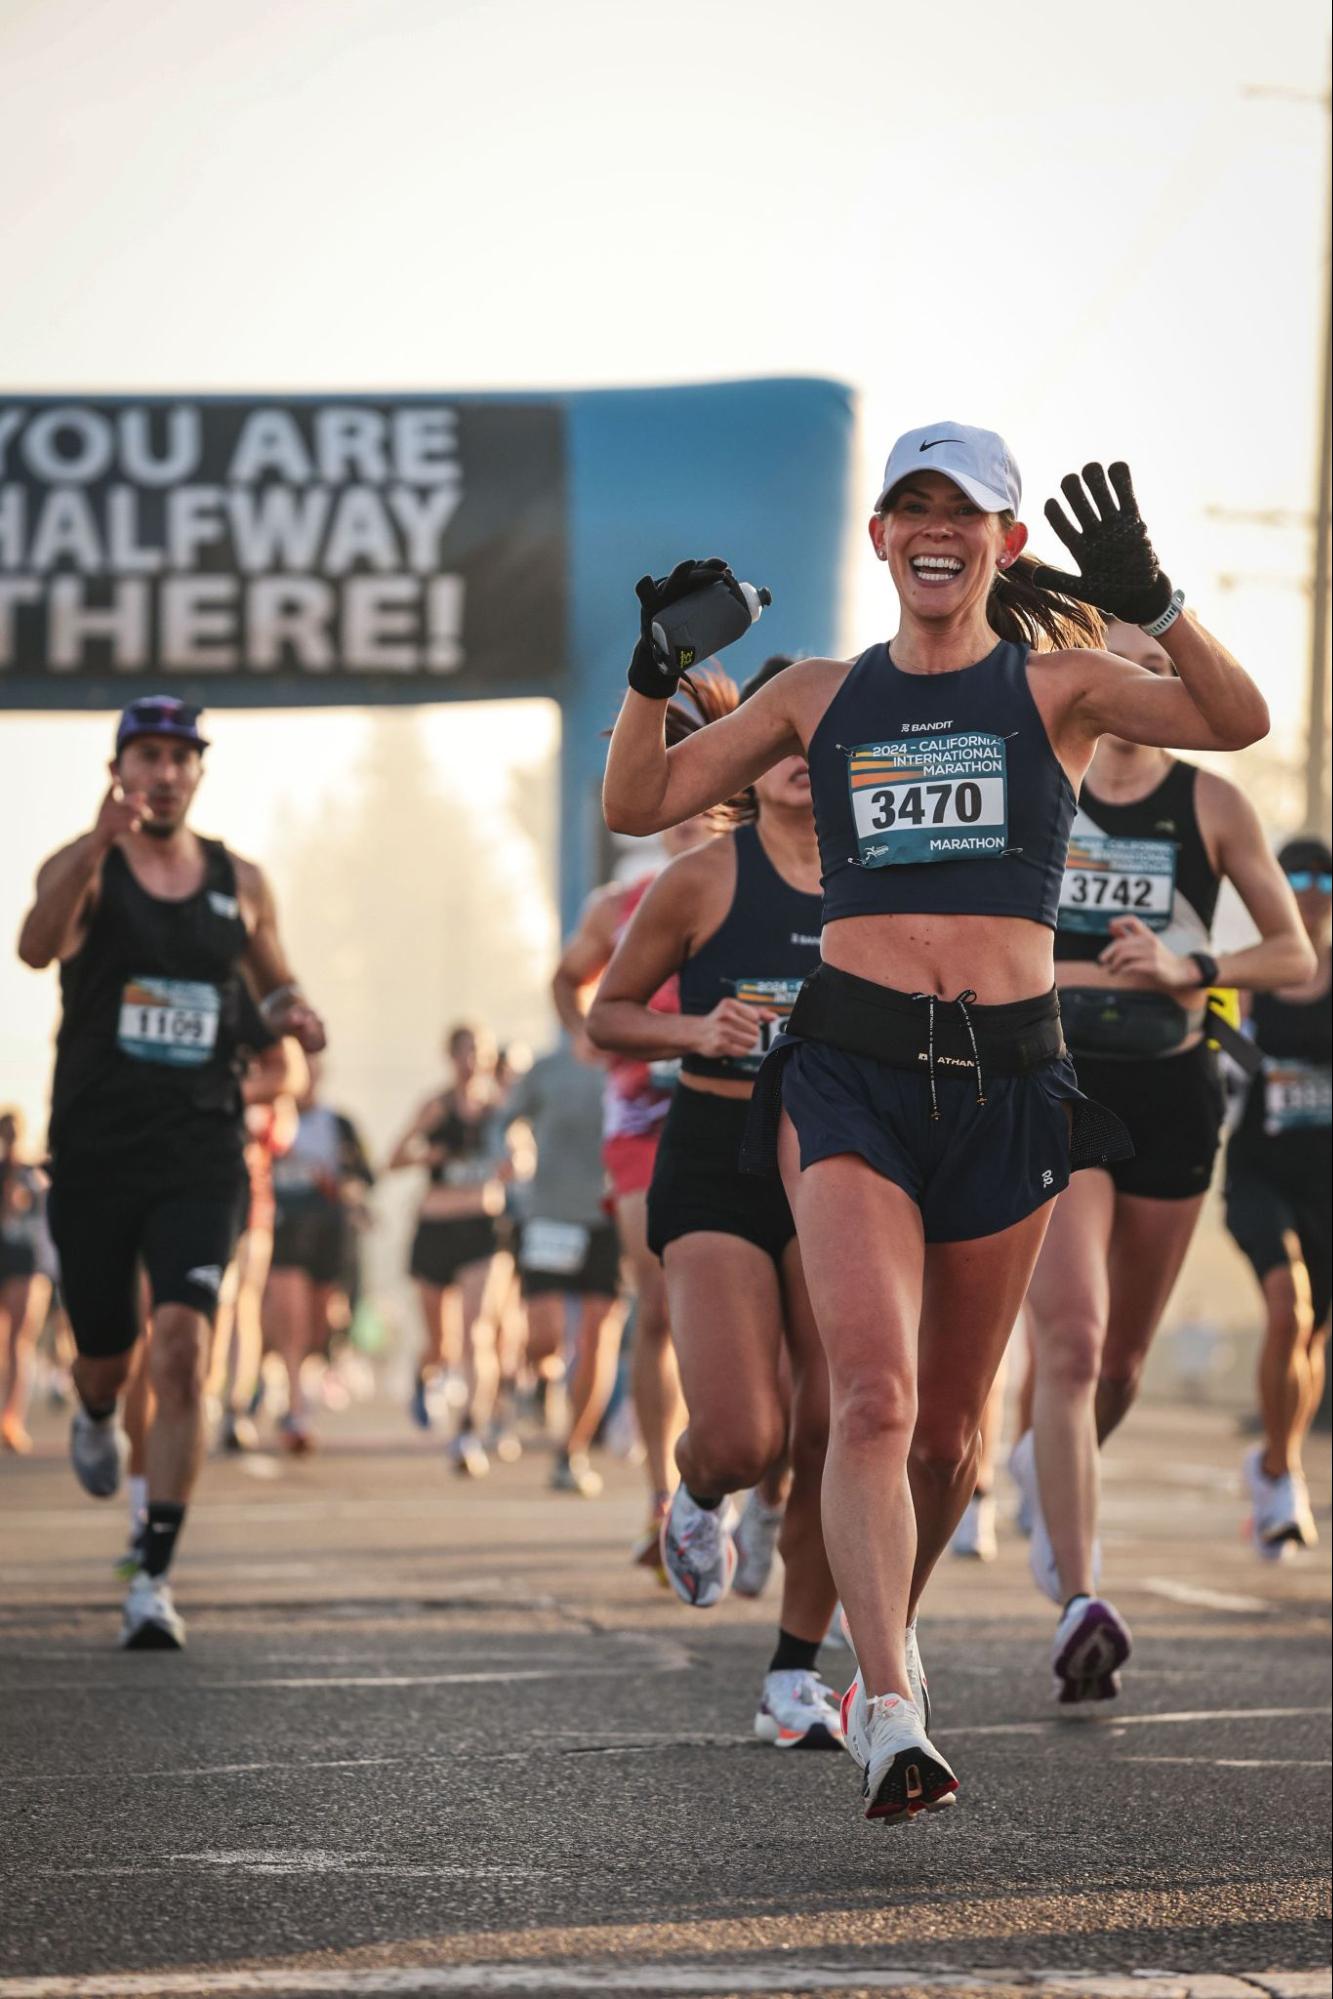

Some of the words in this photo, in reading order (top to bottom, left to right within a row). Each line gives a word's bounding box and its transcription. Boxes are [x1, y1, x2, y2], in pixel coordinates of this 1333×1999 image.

[230, 407, 462, 484] ARE
[0, 484, 461, 574] ALFWAY
[911, 720, 953, 732] BANDIT
[872, 743, 908, 757] 2024
[893, 747, 1002, 767] INTERNATIONAL
[923, 760, 1002, 777] MARATHON
[871, 781, 982, 830] 3470
[930, 837, 1005, 851] MARATHON
[1071, 876, 1152, 907] 3742
